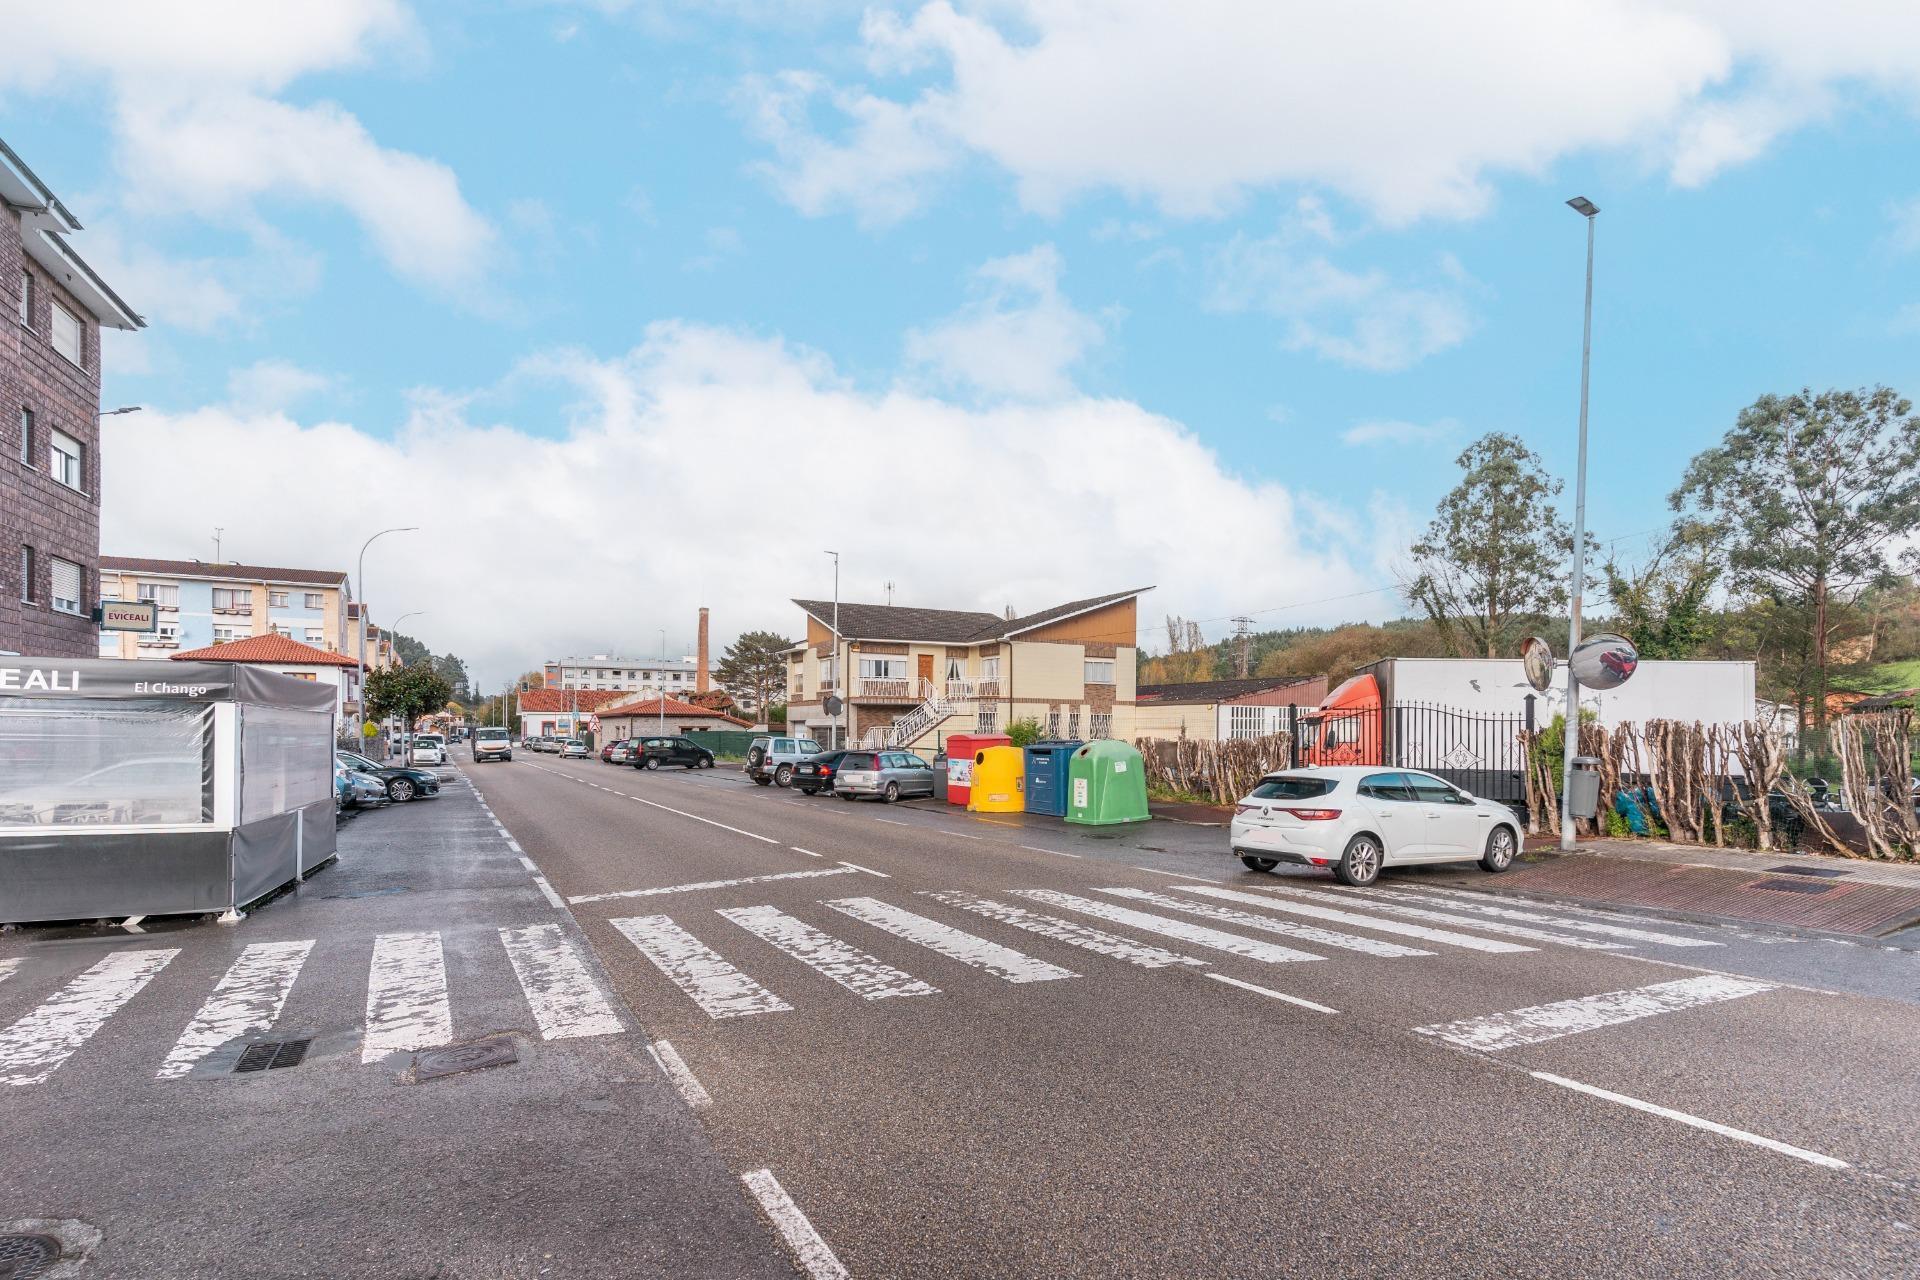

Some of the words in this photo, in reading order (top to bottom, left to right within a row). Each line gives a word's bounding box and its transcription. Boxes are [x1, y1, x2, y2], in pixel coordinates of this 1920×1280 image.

[108, 612, 149, 622] EVICEALI
[134, 682, 148, 693] El
[152, 682, 207, 697] Chango
